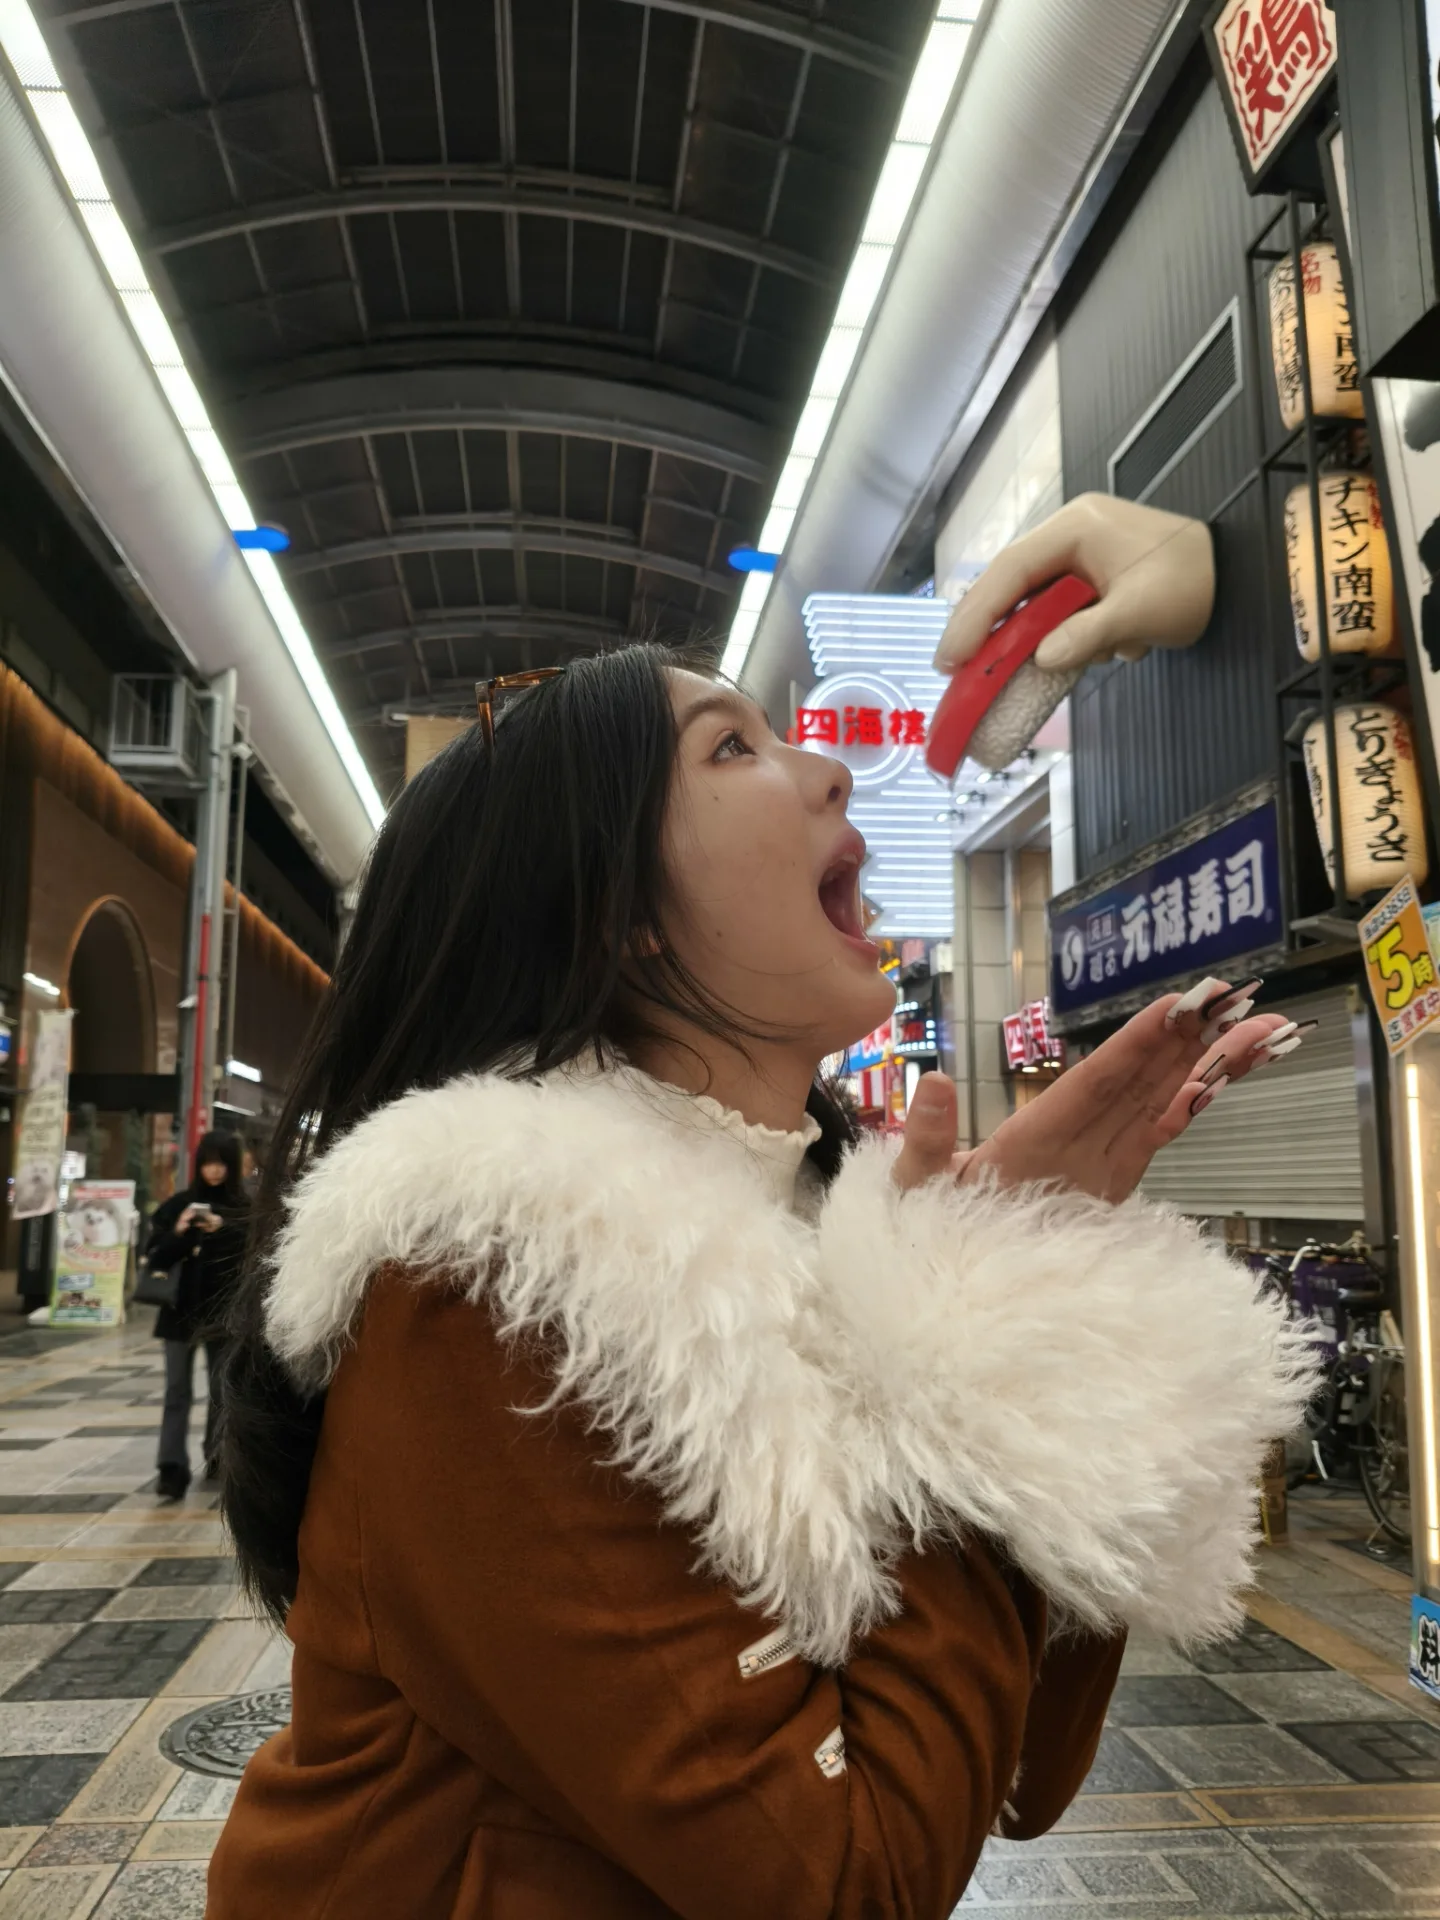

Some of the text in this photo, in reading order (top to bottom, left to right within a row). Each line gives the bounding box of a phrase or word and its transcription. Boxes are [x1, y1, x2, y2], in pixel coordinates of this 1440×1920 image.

[1325, 477, 1376, 635] チキン南蛮
